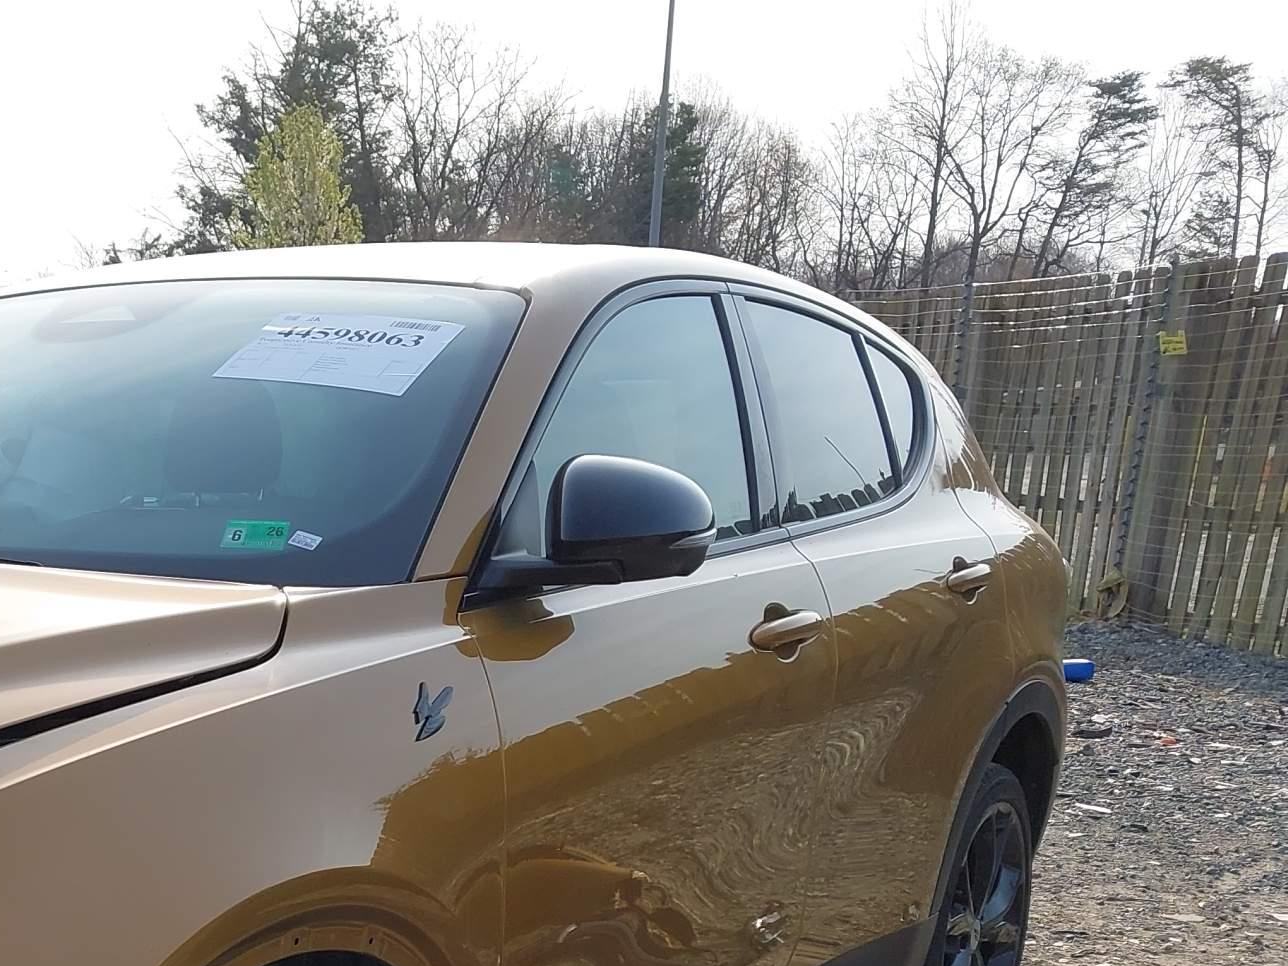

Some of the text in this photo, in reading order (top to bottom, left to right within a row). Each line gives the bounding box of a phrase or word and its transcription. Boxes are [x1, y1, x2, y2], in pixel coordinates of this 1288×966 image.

[277, 325, 425, 348] 44598063
[231, 527, 284, 541] 6 26
